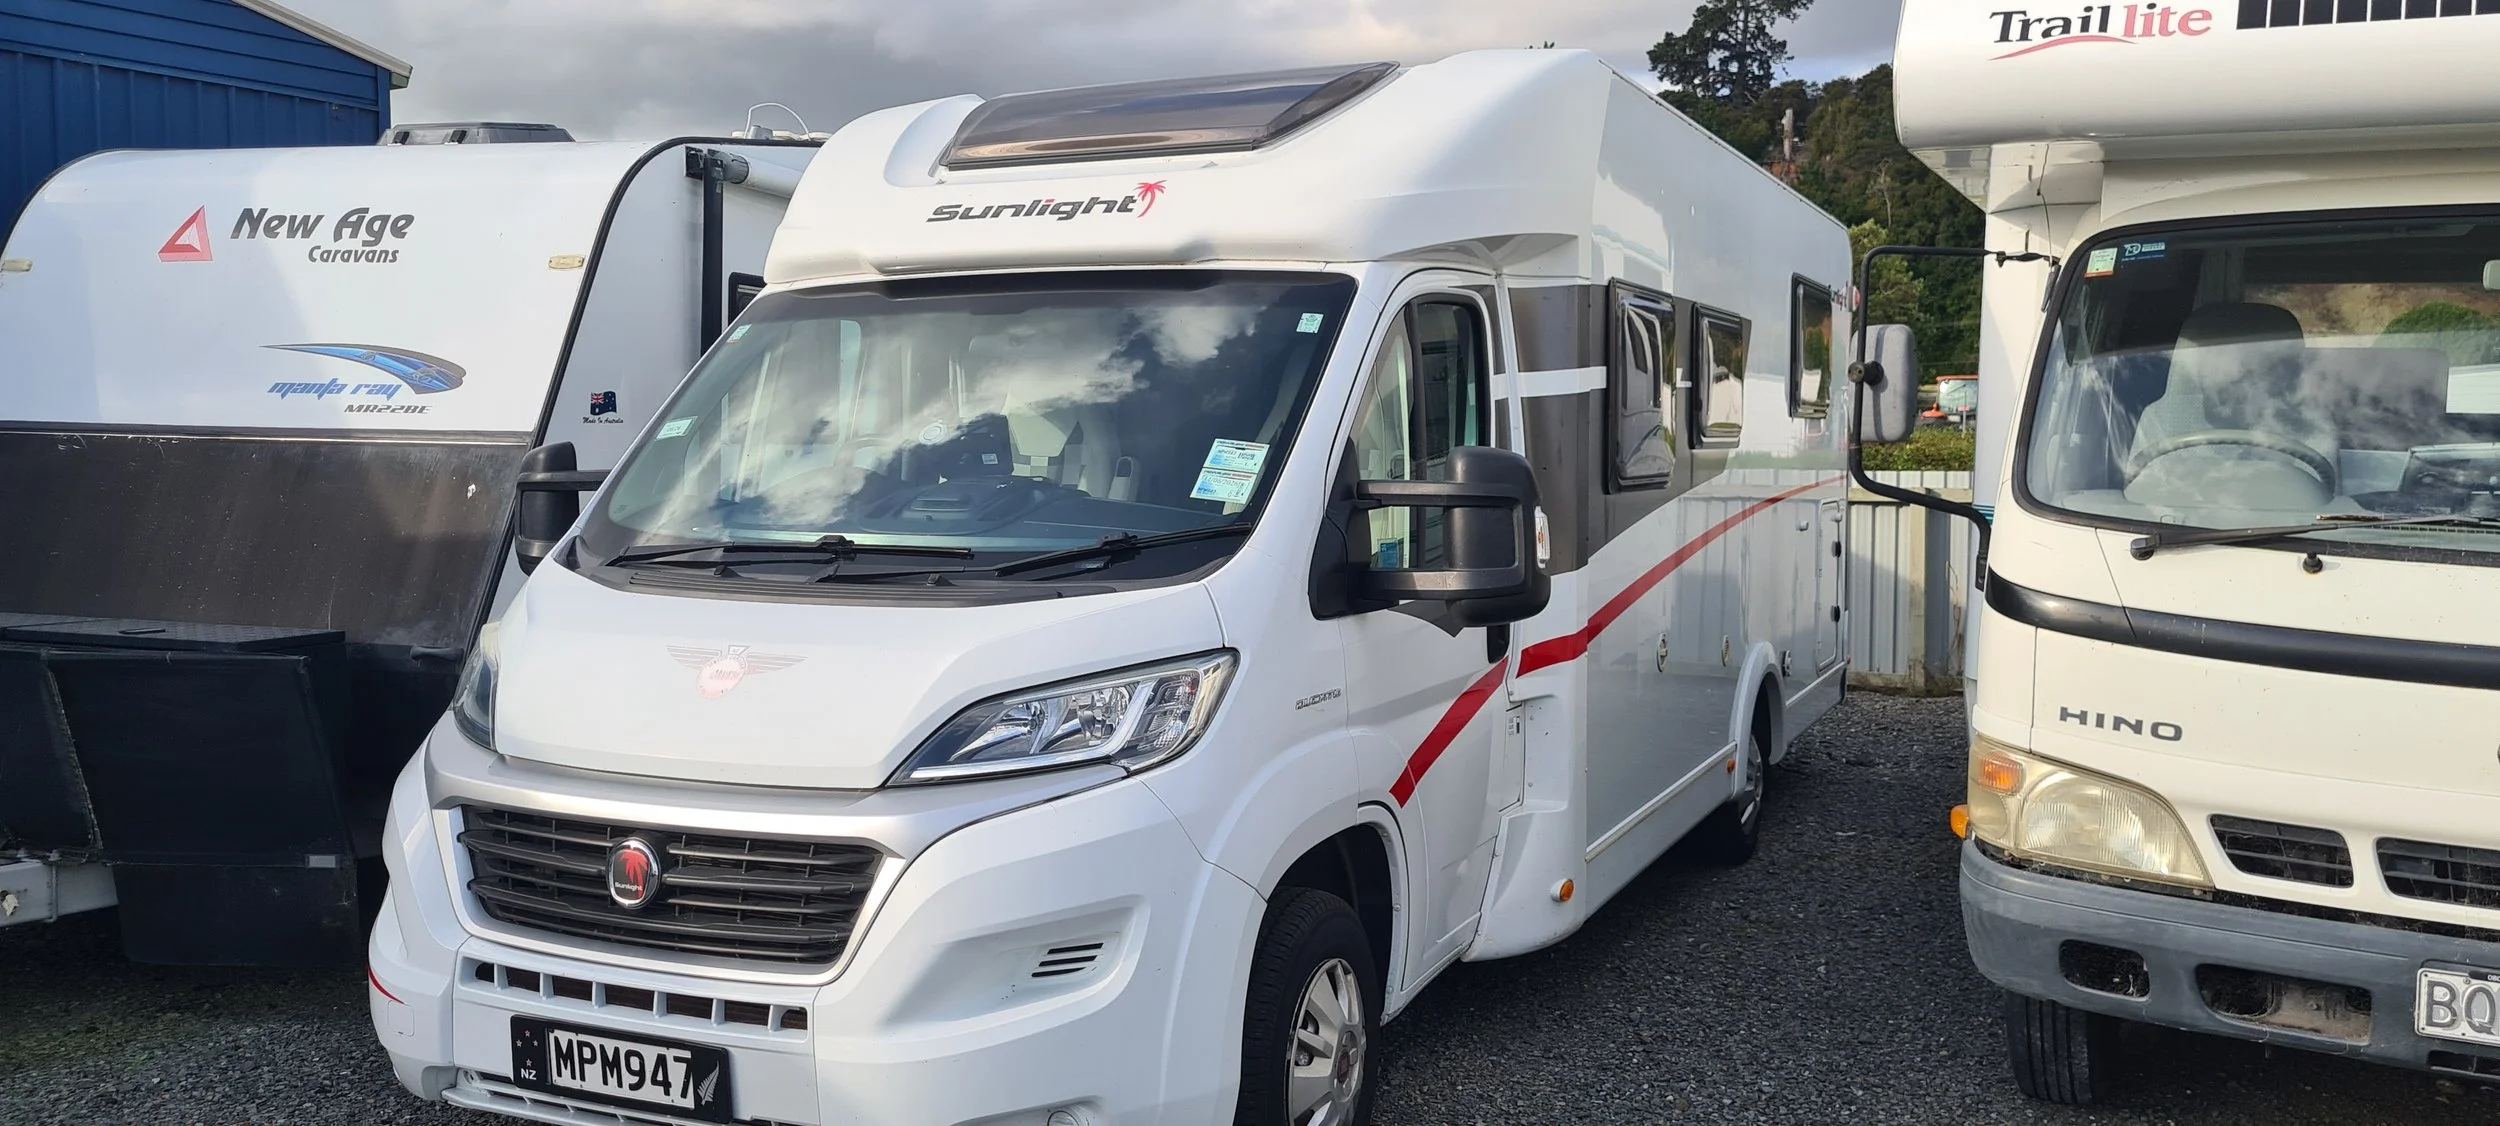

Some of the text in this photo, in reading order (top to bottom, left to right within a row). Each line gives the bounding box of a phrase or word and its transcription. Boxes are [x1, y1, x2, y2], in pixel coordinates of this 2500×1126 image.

[1989, 3, 2214, 43] Trail lite
[926, 195, 1138, 223] Sunlight
[230, 207, 415, 247] New Age
[308, 245, 399, 263] Caravans
[267, 378, 402, 401] manta ray
[2059, 706, 2183, 741] HINO
[615, 881, 643, 892] Sunlight
[521, 1068, 537, 1081] NZ
[554, 1036, 694, 1099] MPM947
